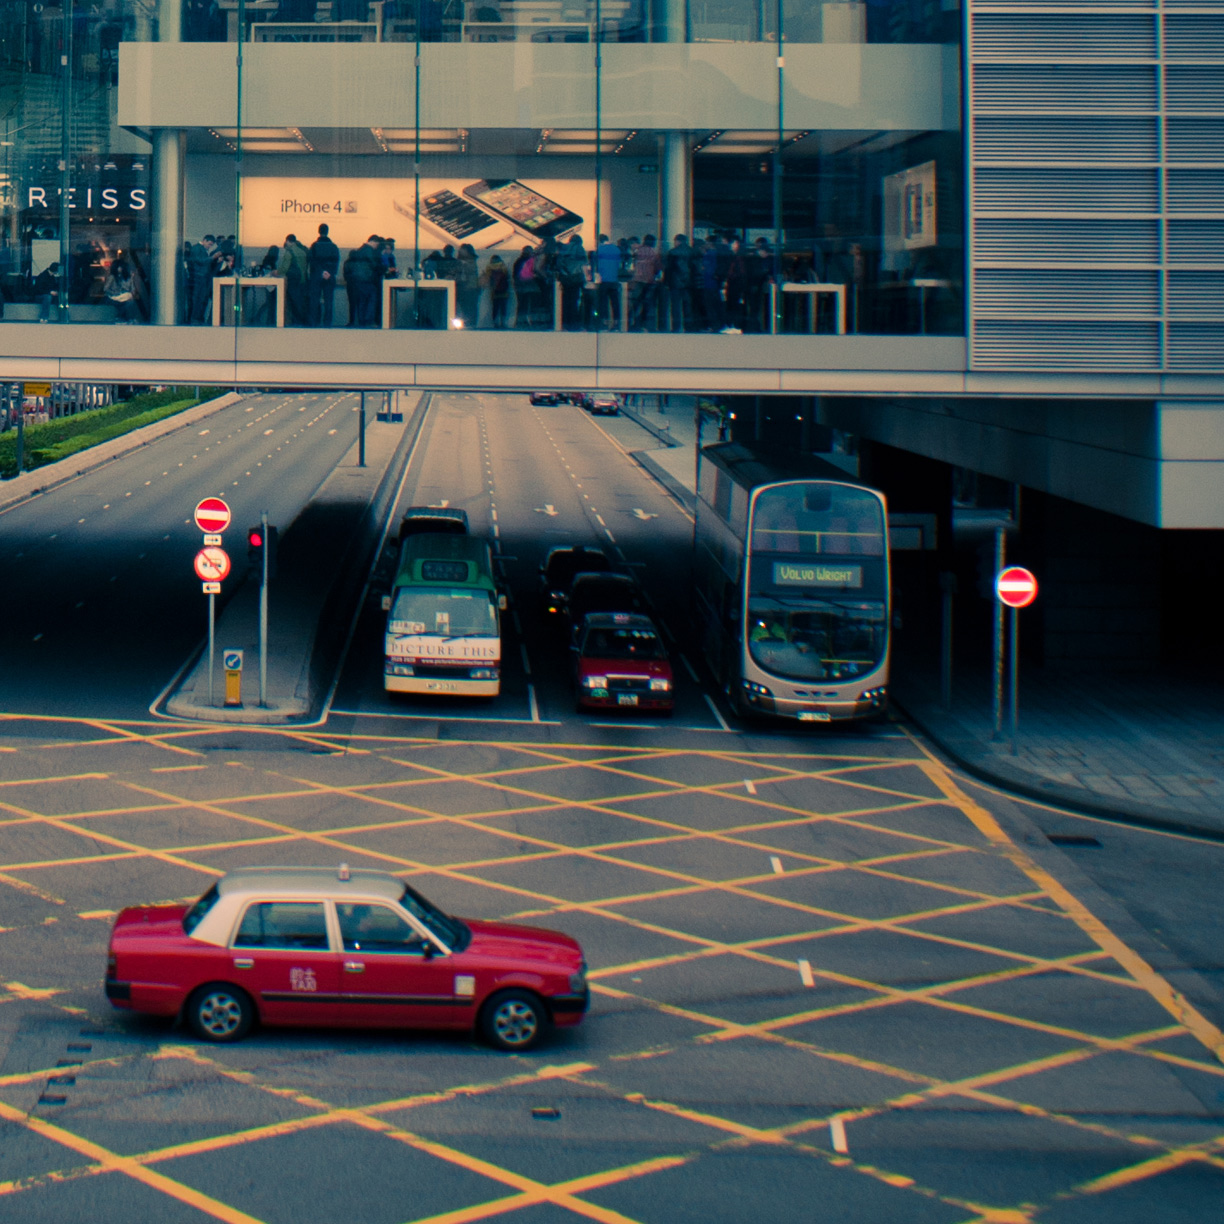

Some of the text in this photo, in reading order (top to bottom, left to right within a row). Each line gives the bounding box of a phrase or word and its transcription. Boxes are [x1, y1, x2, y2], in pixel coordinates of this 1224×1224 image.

[28, 187, 146, 210] REISS
[281, 199, 331, 213] iPhone
[391, 643, 496, 657] PICTURE THIS
[290, 967, 317, 980] 的士
[291, 979, 317, 992] TAXI
